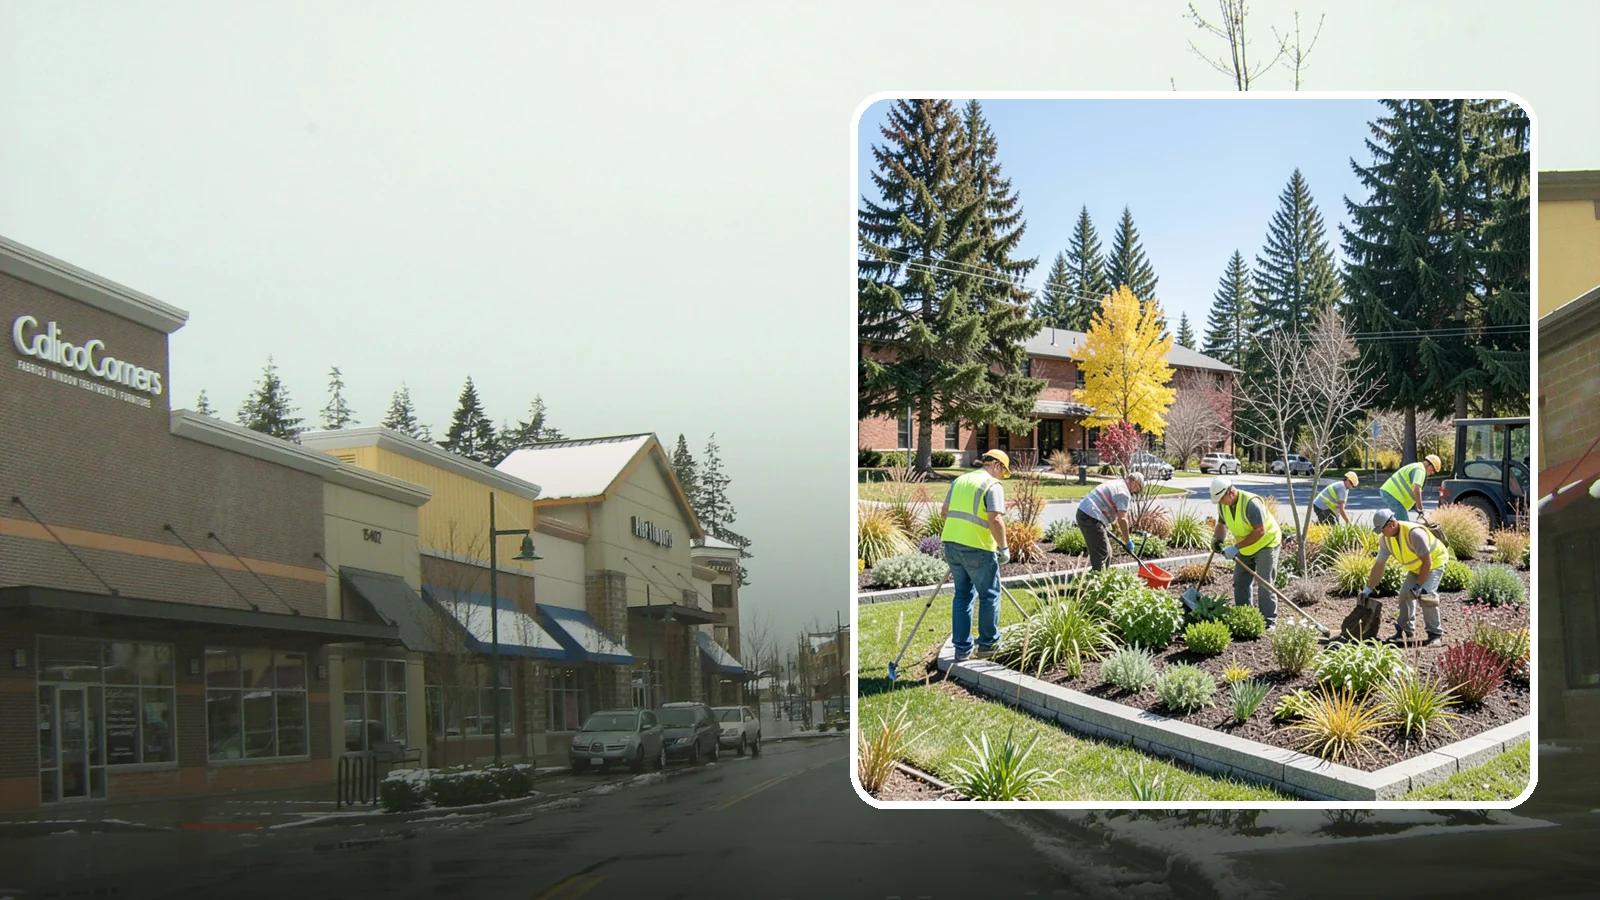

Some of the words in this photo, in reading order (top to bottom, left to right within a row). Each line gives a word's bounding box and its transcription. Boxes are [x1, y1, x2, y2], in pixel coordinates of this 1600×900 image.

[17, 360, 47, 377] FABRICS
[51, 370, 77, 386] WINDOW
[78, 378, 116, 398] TREATMENTS
[120, 391, 151, 409] FURNITURE
